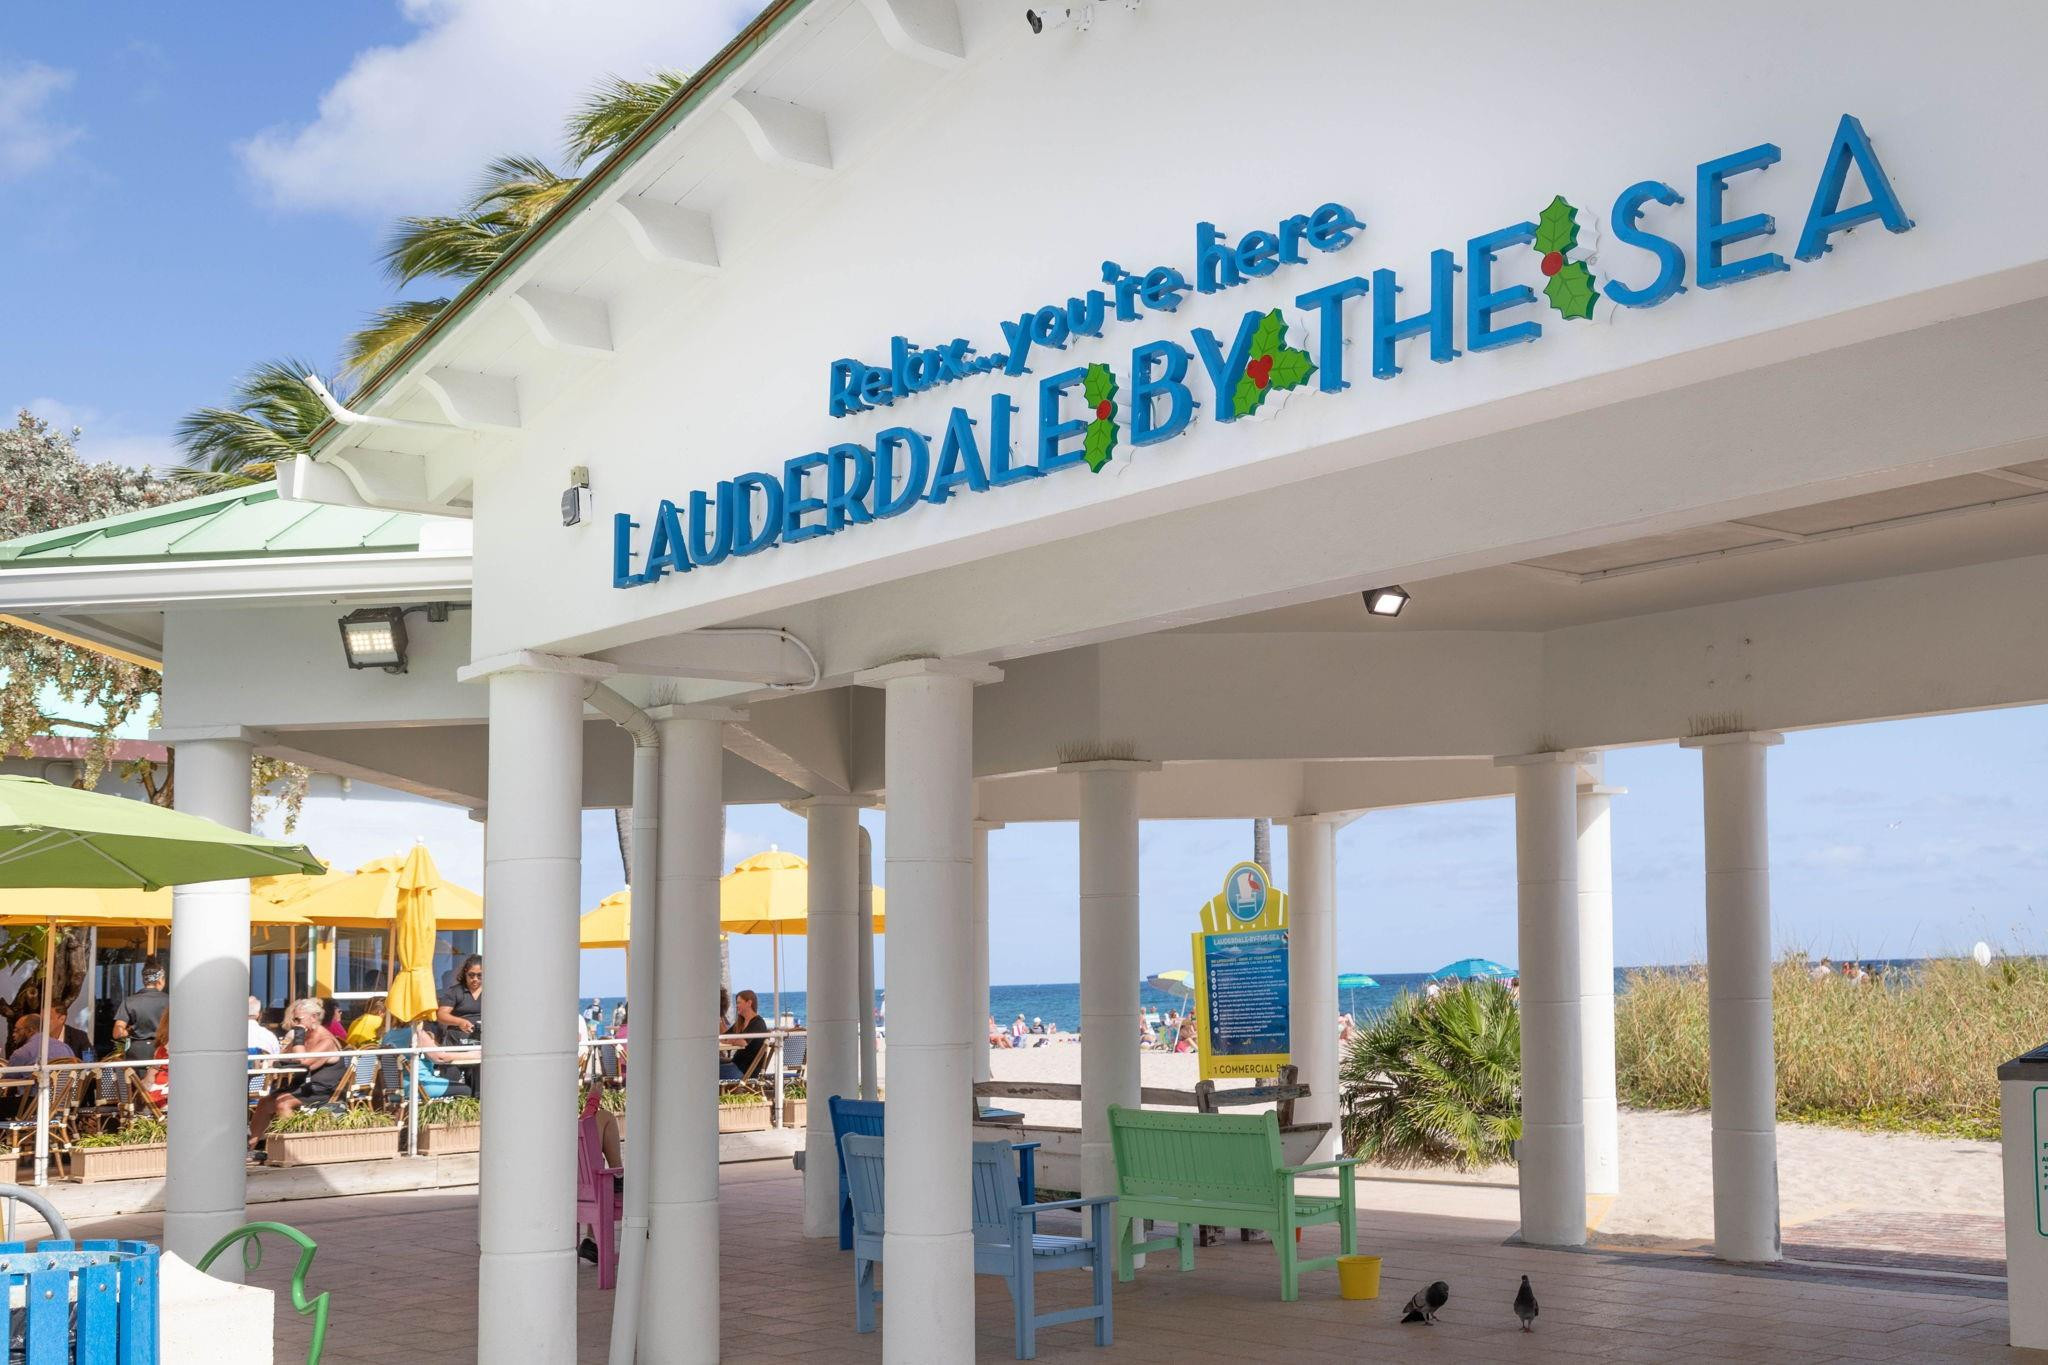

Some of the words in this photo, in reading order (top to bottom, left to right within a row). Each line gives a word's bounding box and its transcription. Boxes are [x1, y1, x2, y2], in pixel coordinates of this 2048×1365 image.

[1197, 203, 1363, 295] here
[614, 367, 1090, 590] LAUDERDALE
[1131, 310, 1268, 446] BY
[1295, 222, 1542, 394] THE
[1603, 113, 1911, 309] SEA
[1219, 1064, 1275, 1074] COMMERCIAL
